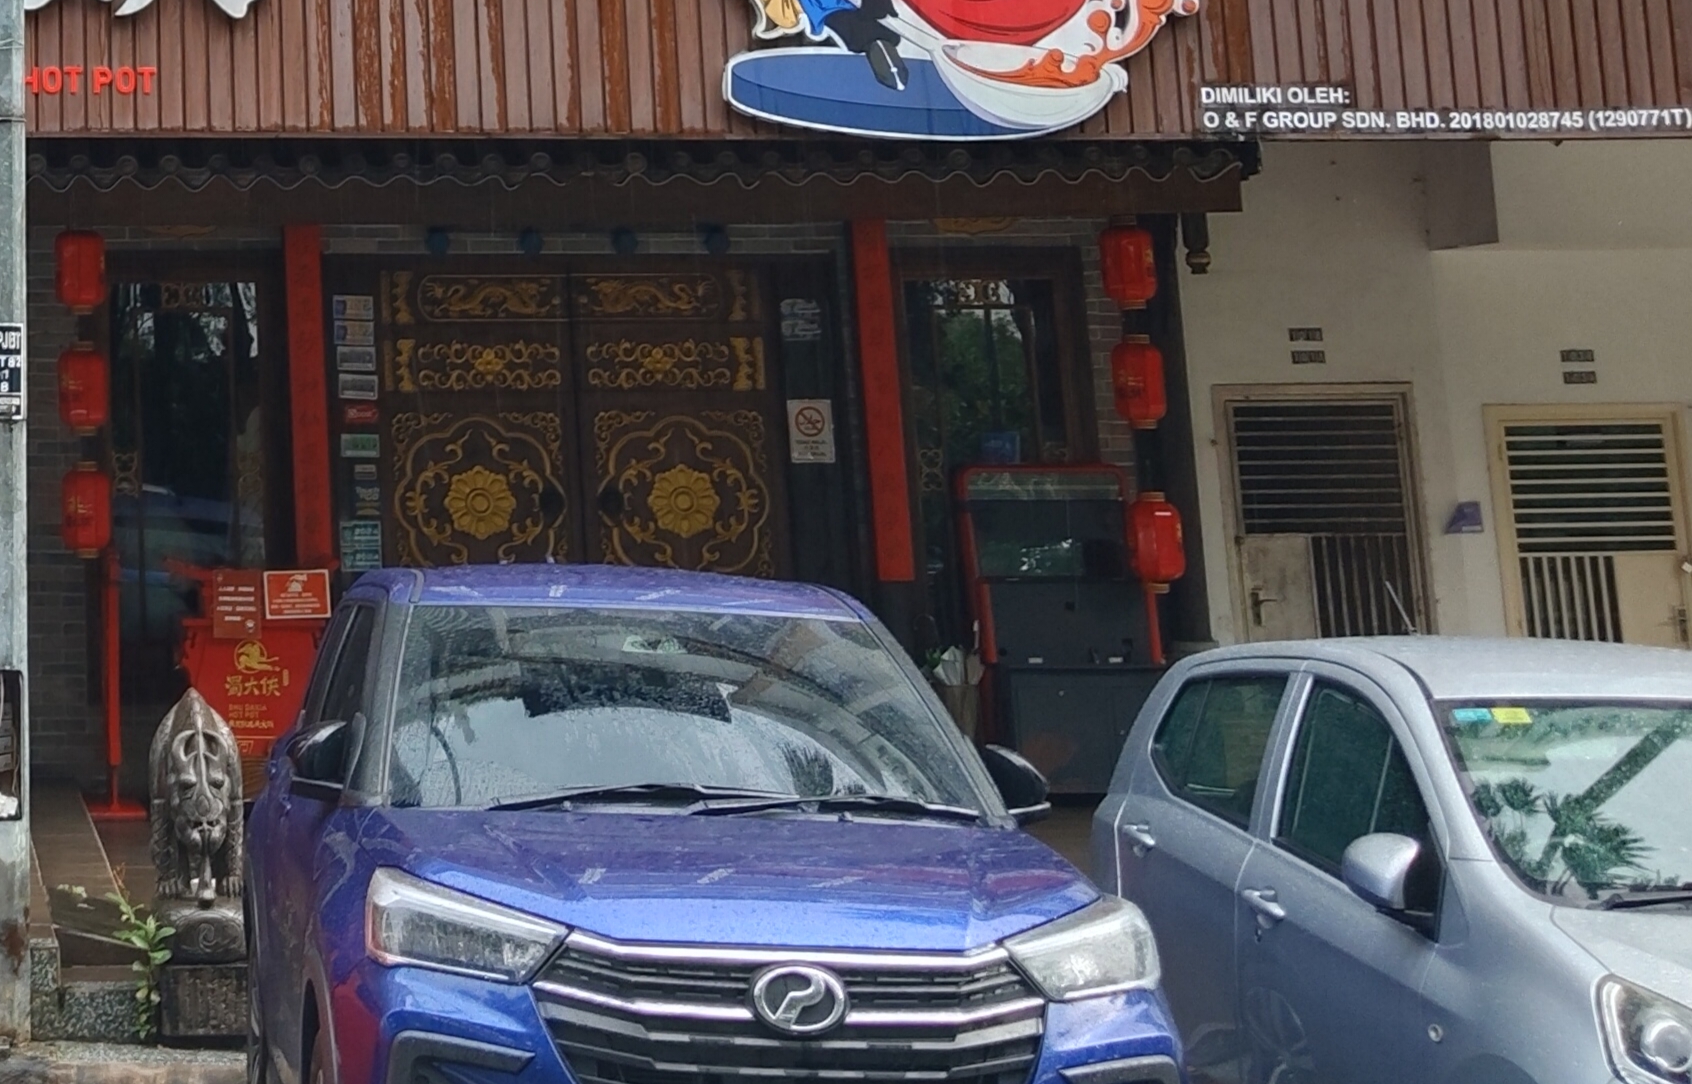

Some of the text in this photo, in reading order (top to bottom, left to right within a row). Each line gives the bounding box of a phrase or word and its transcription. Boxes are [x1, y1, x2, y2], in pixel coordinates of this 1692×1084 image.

[93, 66, 157, 94] POT
[1201, 87, 1351, 105] DIMILIKI OLEH:
[1203, 108, 1692, 132] O & F GROUP SDN. BHD. 201801028745 (1290771T)
[225, 676, 281, 696] 蜀大侠
